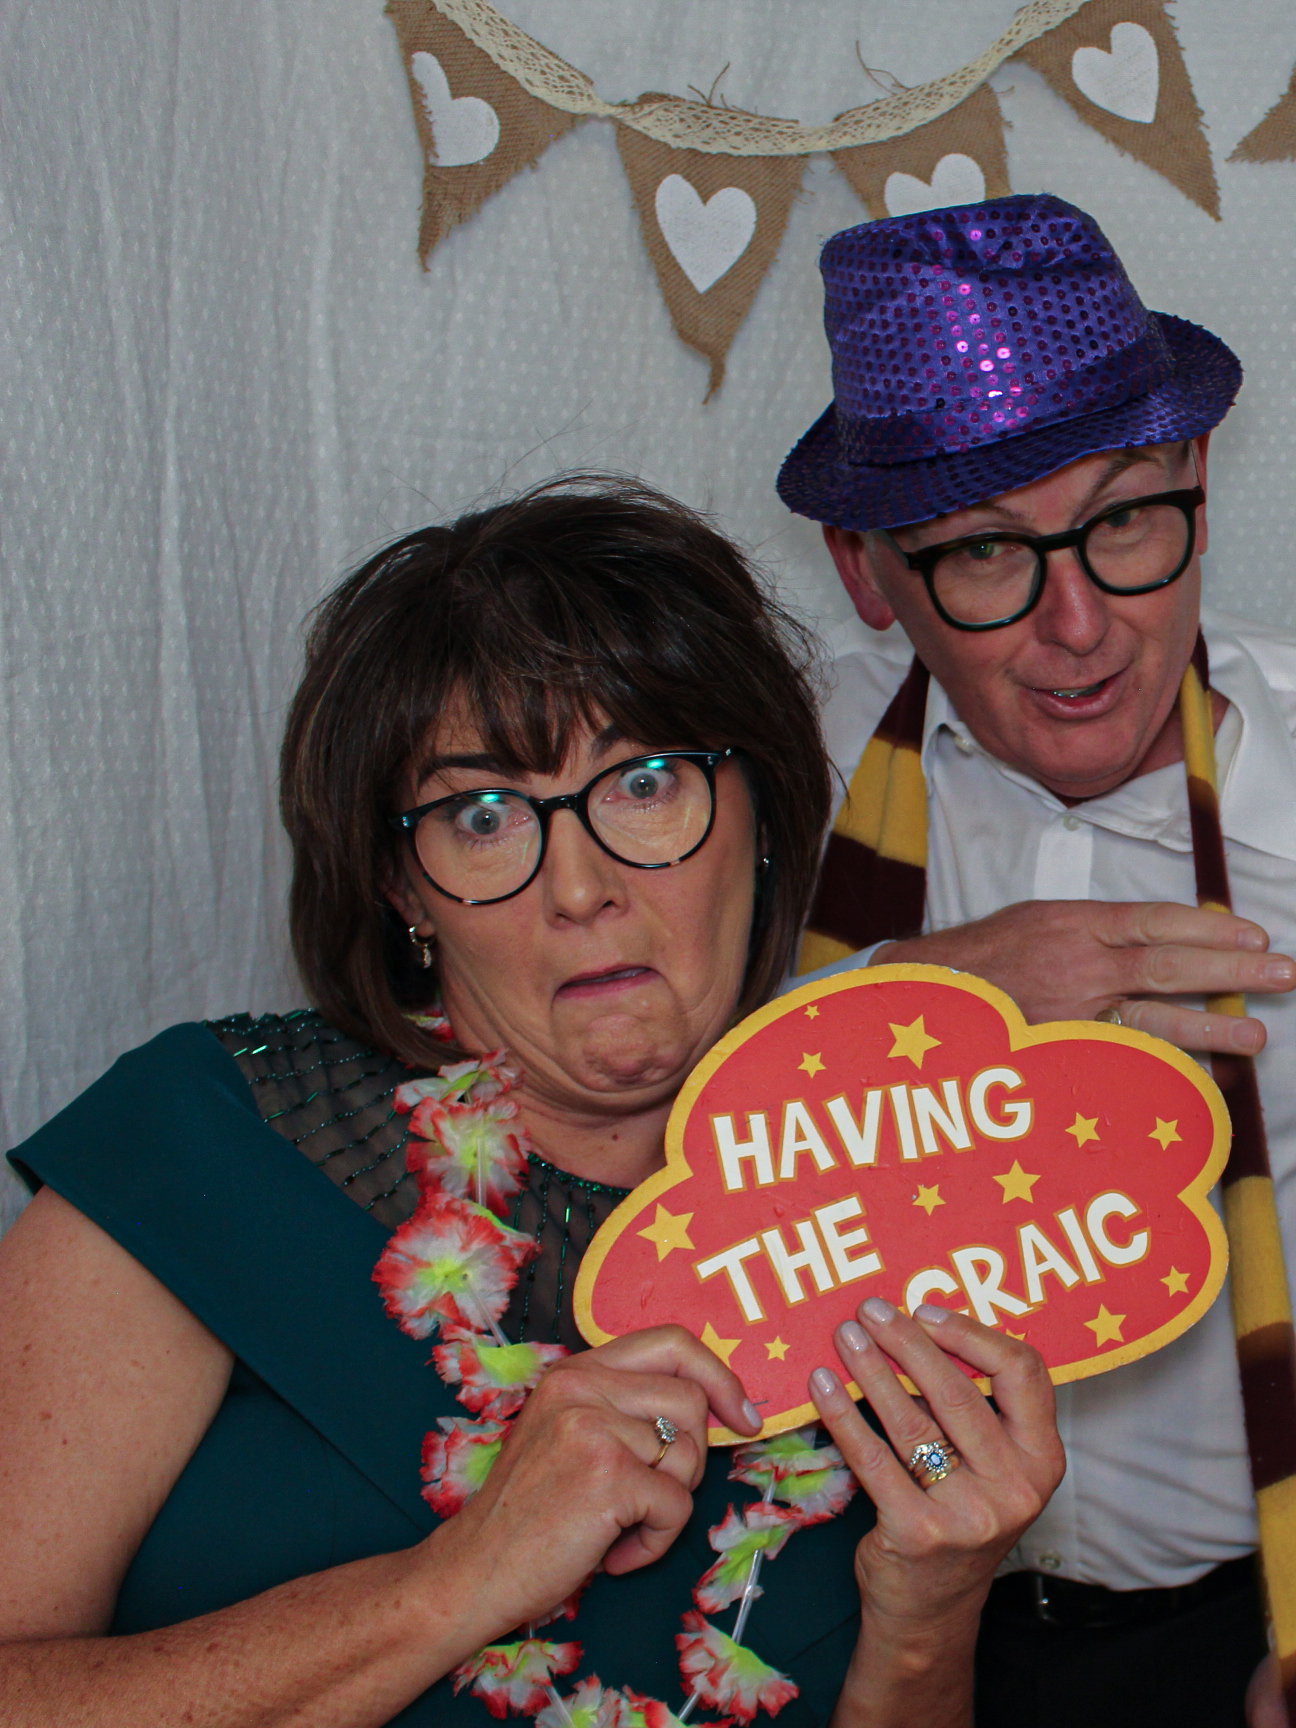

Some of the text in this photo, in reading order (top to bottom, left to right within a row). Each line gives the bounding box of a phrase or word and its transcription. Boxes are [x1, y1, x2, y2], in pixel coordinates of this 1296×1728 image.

[713, 1067, 1033, 1190] HAVING
[697, 1192, 1149, 1326] THE CRAIC
